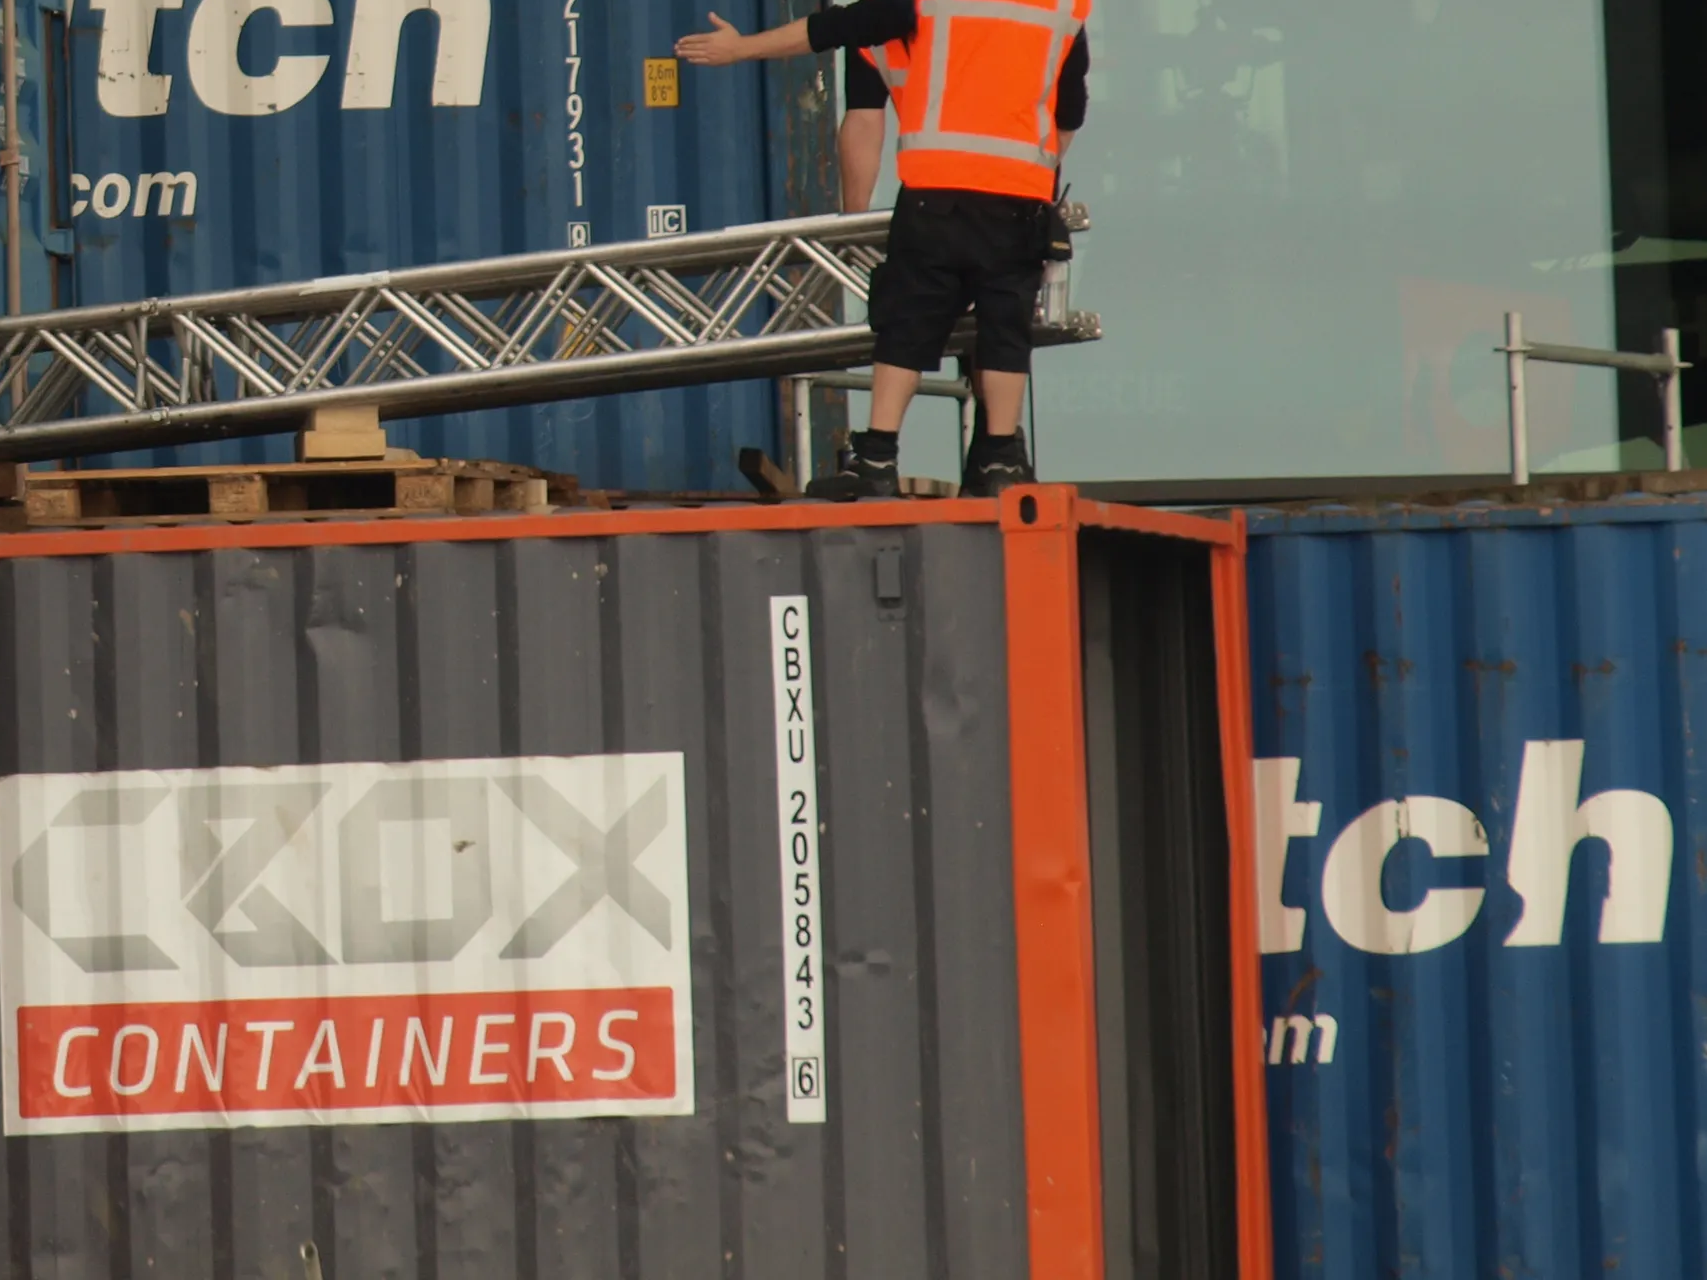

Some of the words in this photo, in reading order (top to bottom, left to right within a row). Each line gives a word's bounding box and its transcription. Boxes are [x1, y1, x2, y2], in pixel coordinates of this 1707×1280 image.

[647, 64, 675, 84] 2,6m
[782, 606, 805, 764] CBXU
[790, 790, 814, 1031] 205843
[52, 1009, 640, 1099] CONTAINERS
[1261, 1013, 1338, 1066] m
[795, 1059, 816, 1096] 6
